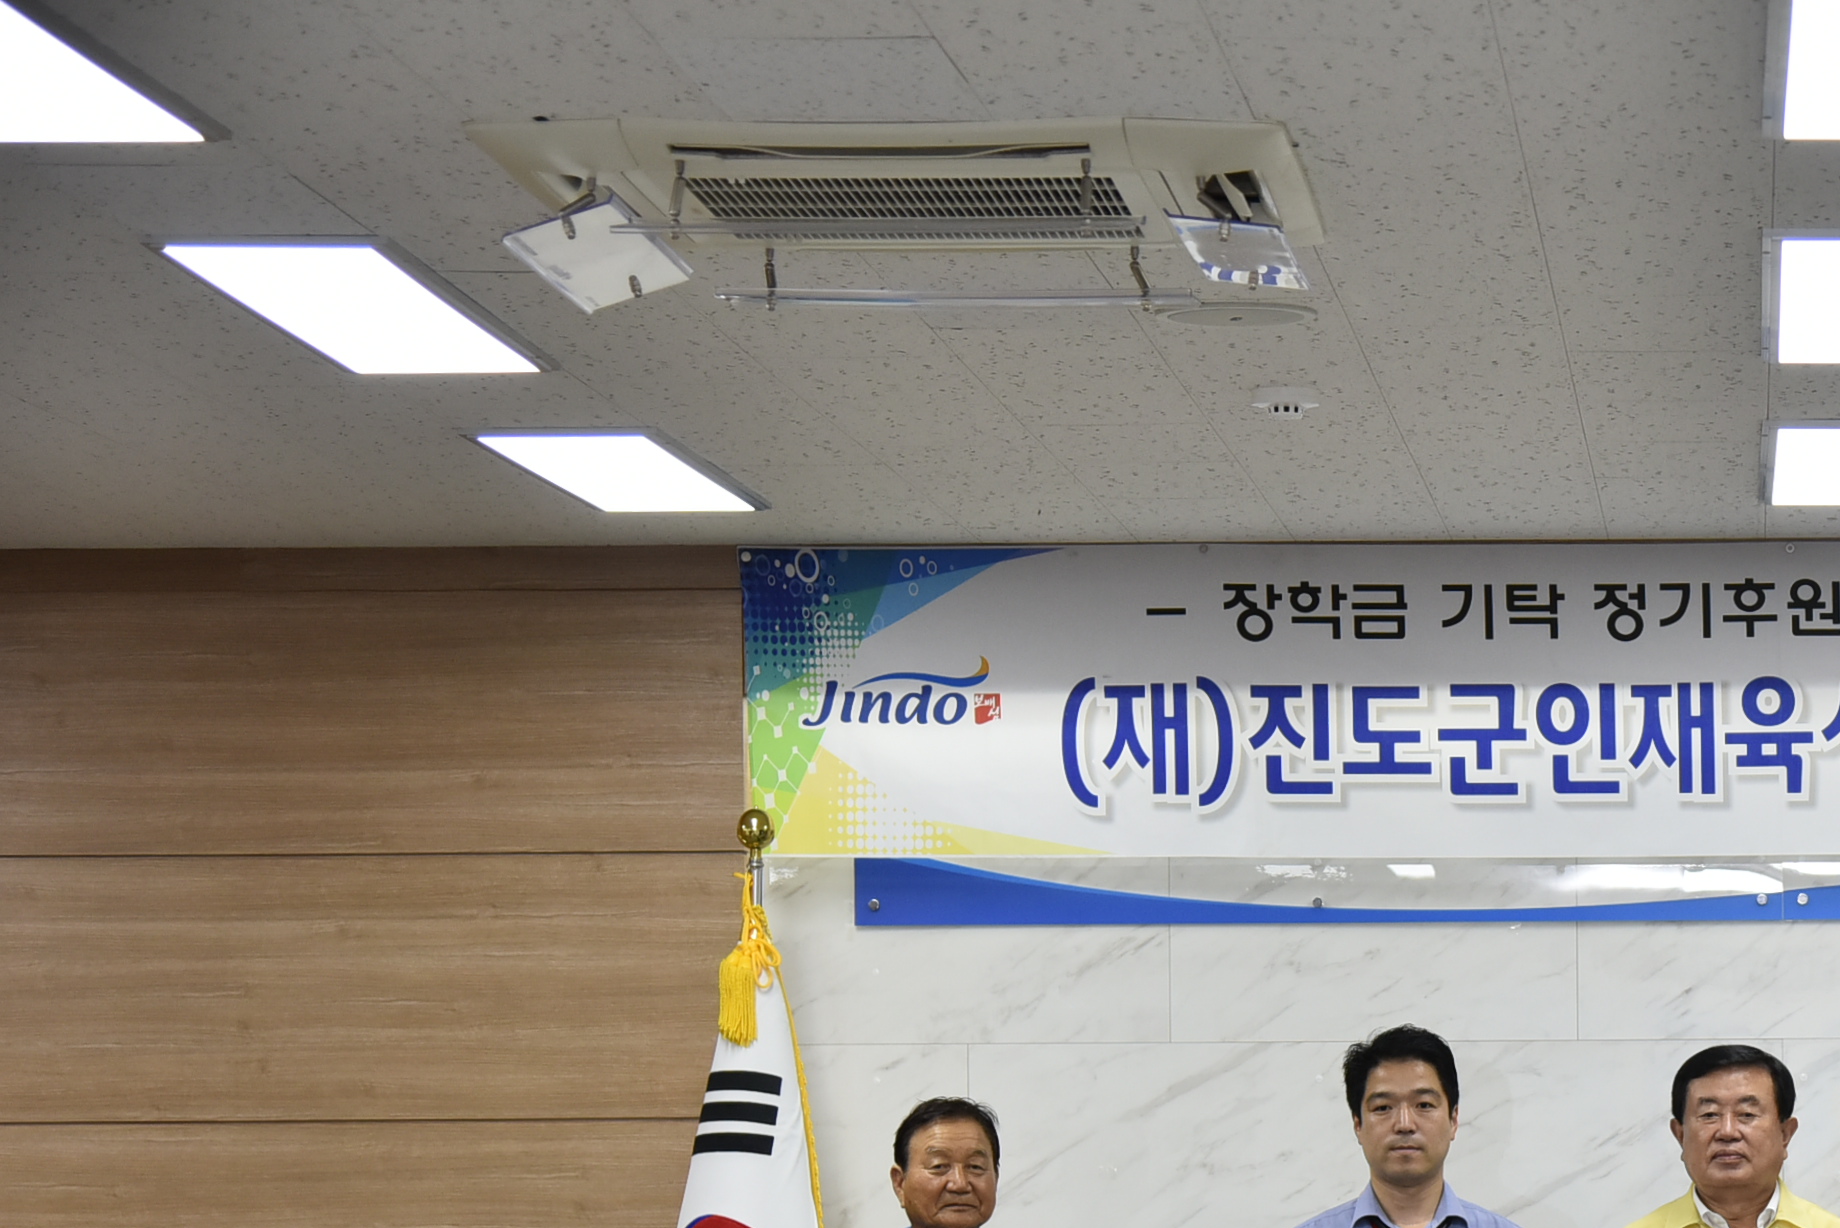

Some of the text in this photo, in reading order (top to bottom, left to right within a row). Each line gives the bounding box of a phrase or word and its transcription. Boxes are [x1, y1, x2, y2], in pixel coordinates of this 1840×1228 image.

[1222, 580, 1408, 643] 장학금
[1441, 583, 1566, 640] 기탁
[802, 680, 968, 726] Jindo
